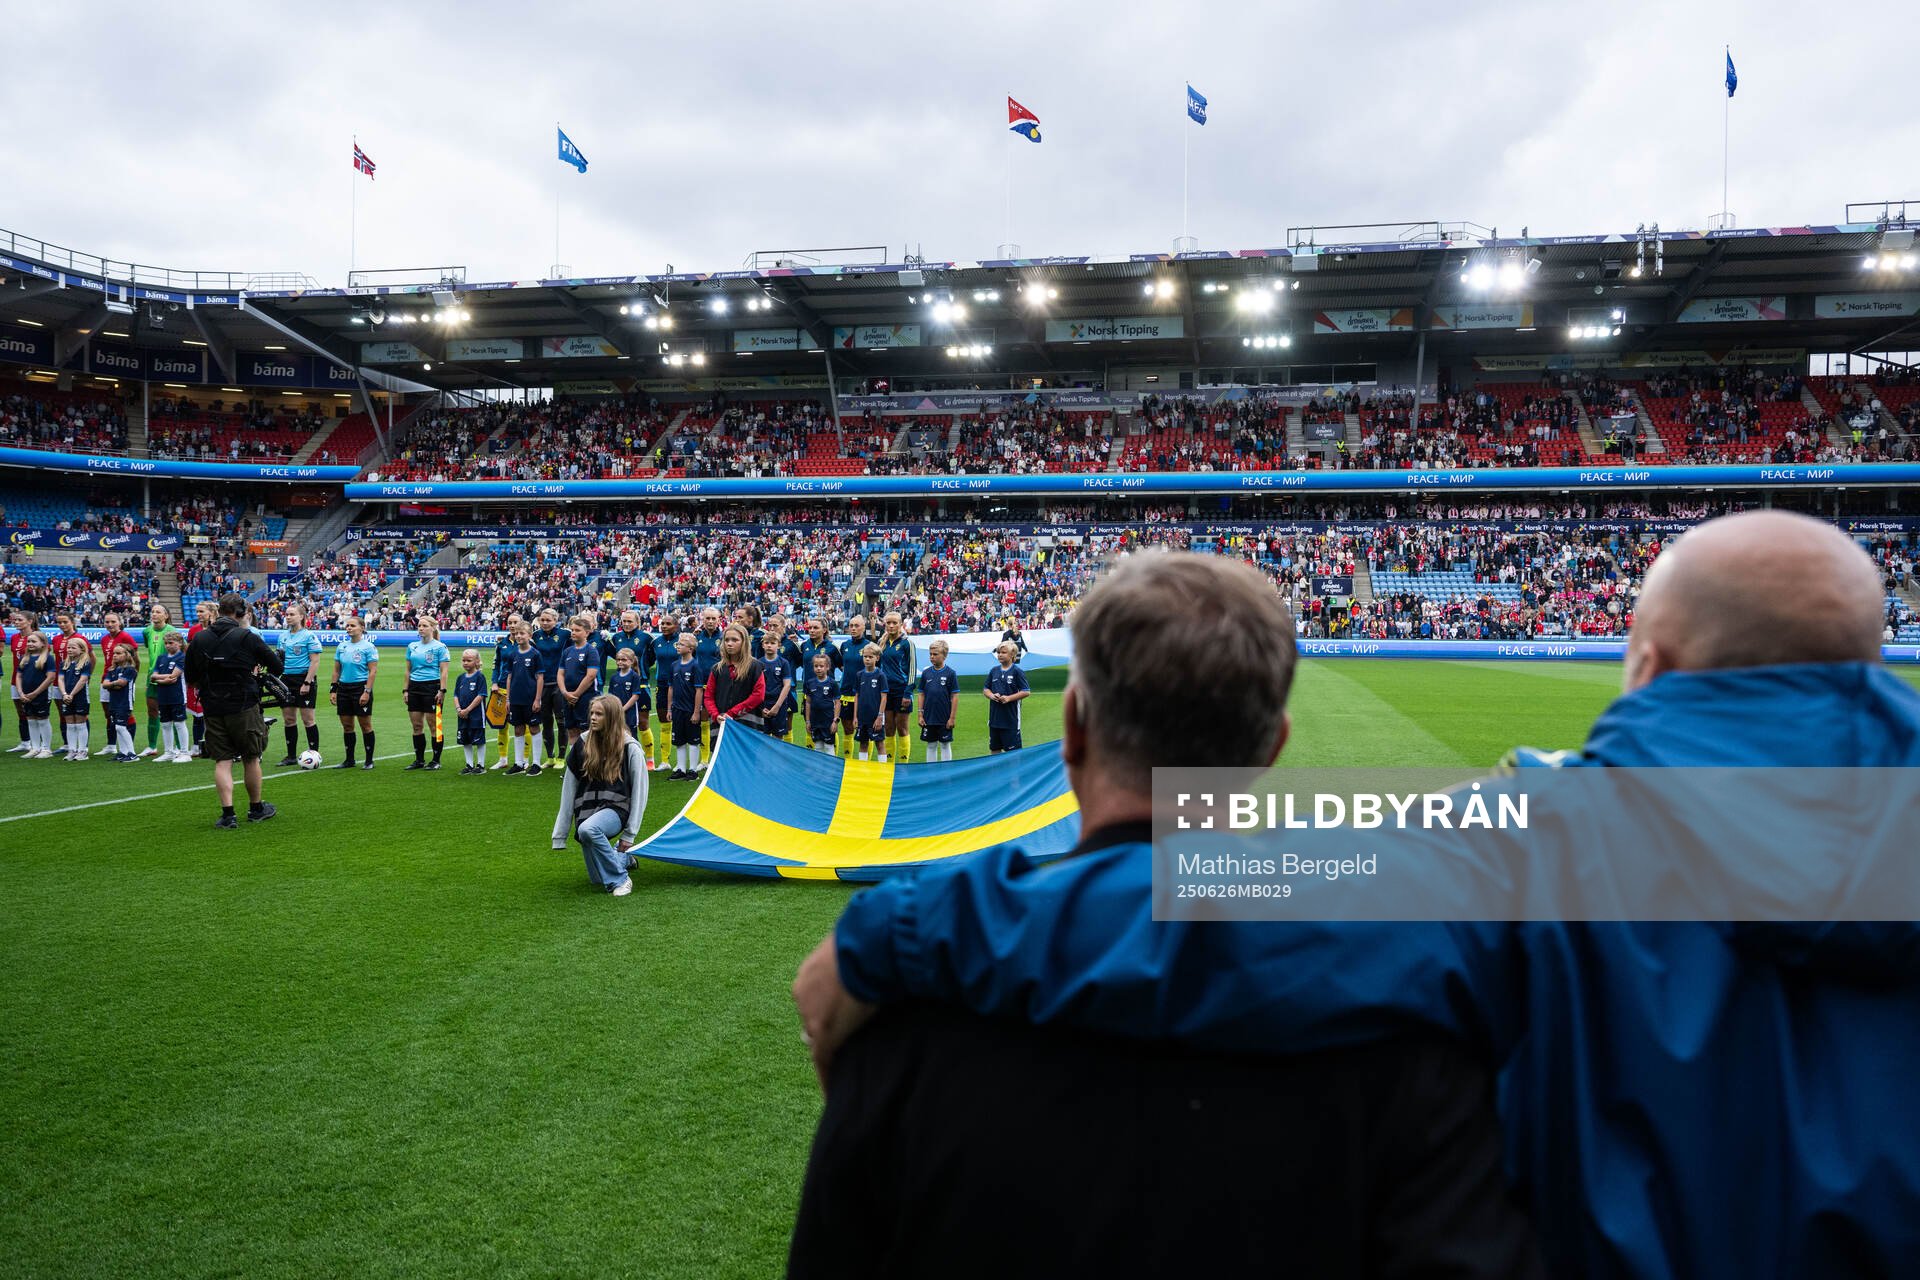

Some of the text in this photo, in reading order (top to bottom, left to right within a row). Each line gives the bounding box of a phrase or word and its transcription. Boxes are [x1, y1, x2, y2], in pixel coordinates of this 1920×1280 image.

[1849, 301, 1902, 312] Norsk Tipping
[1088, 323, 1159, 338] Norsk Tipping
[0, 338, 36, 354] ama
[96, 350, 139, 369] bama
[154, 359, 196, 373] bama
[253, 362, 295, 377] bama
[88, 459, 120, 470] PEACE
[260, 468, 289, 477] PEACE
[1580, 472, 1614, 481] PEACE
[1760, 470, 1796, 479] PEACE
[931, 480, 960, 489] PEACE
[1083, 478, 1113, 487] PEACE
[1242, 476, 1273, 485] PEACE
[1407, 475, 1439, 484] PEACE
[382, 486, 407, 494] PEACE
[512, 485, 537, 494] PEACE
[646, 483, 673, 492] PEACE
[786, 482, 814, 490] PEACE
[17, 530, 42, 541] Bendit
[66, 533, 91, 544] Bendit
[106, 534, 130, 545] Bendit
[153, 536, 177, 547] Bendit
[321, 634, 347, 642] PEACE
[466, 635, 497, 644] PEACE
[1305, 643, 1340, 654] PEACE
[1498, 645, 1535, 656] PEACE
